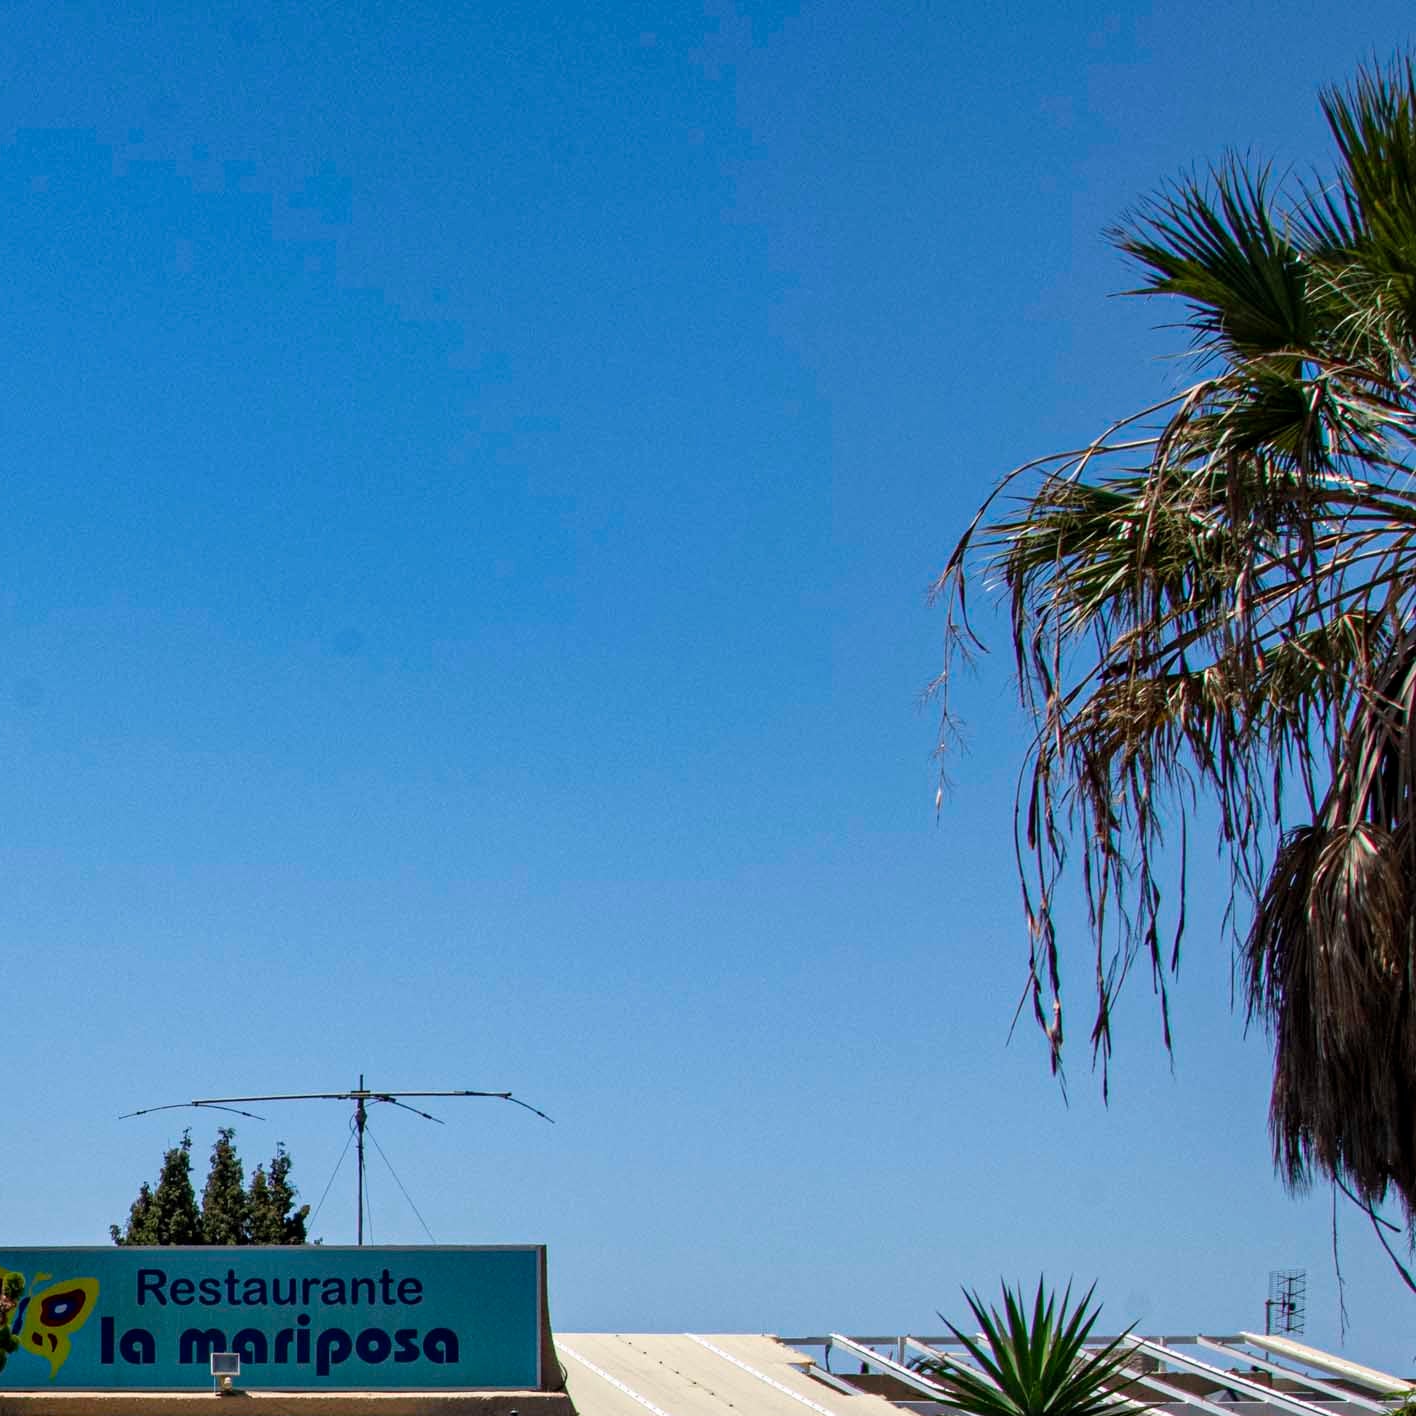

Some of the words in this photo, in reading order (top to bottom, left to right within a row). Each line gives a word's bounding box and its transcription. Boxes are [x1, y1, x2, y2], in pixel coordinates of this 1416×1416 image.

[136, 1267, 424, 1306] Restaurante
[99, 1314, 156, 1365] la
[178, 1312, 460, 1377] mariposa
